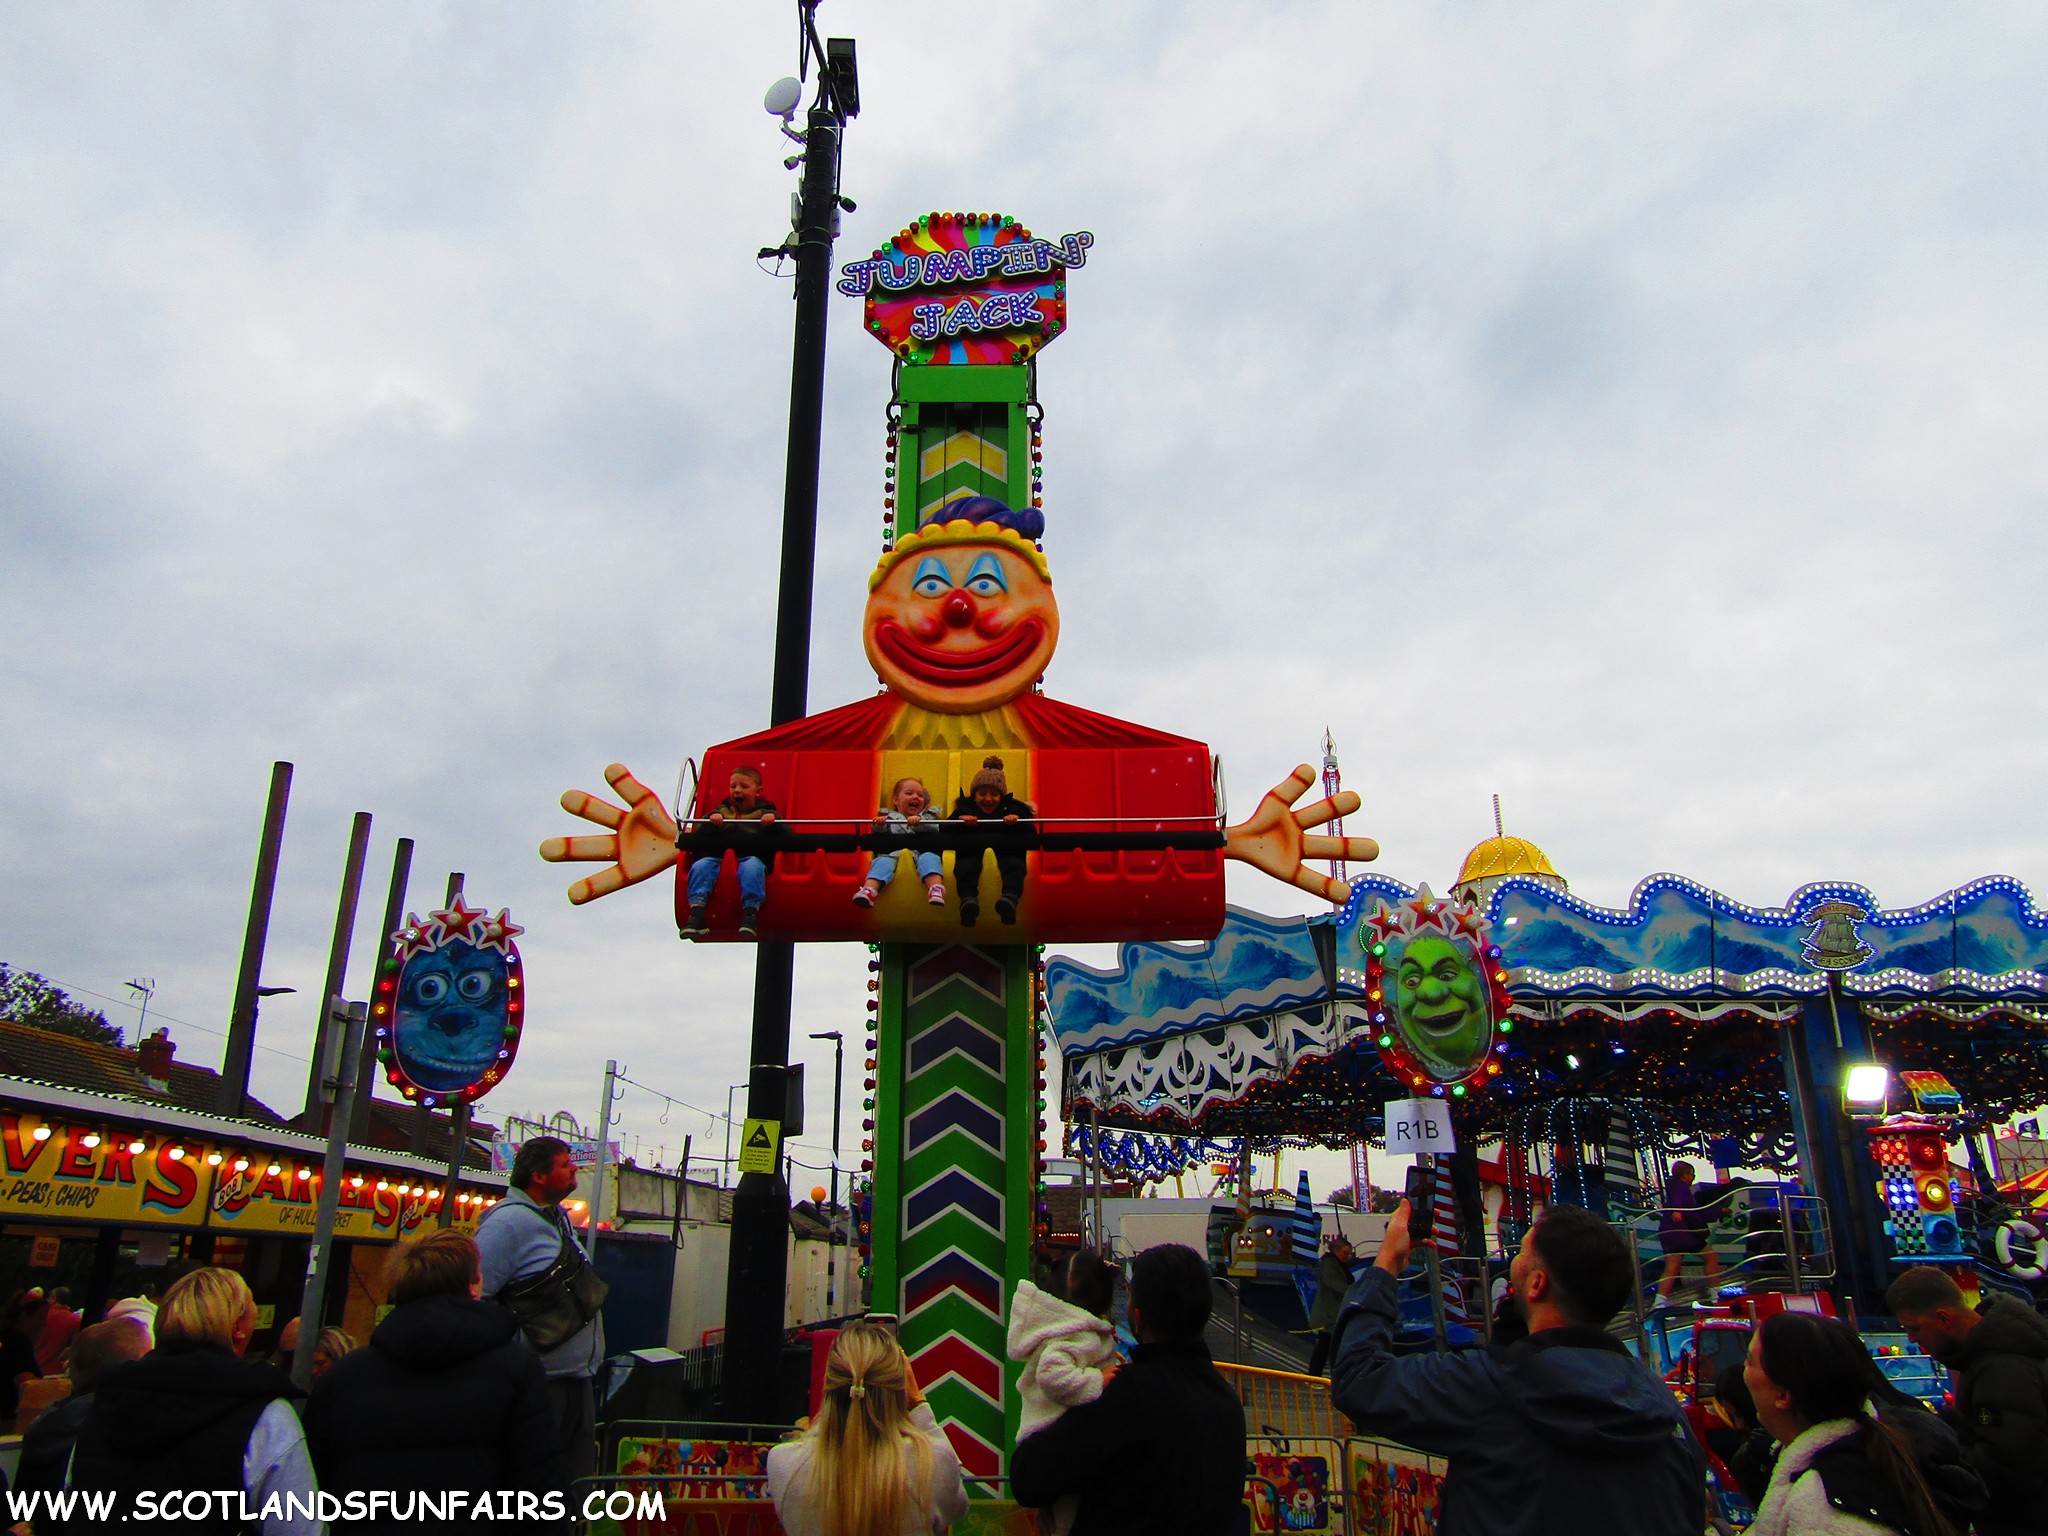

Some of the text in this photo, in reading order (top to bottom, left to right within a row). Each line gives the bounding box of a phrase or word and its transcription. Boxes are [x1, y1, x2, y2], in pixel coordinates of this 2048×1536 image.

[837, 230, 1094, 297] JUMPIN'
[909, 291, 1044, 341] JACK
[1397, 1120, 1439, 1141] R1B
[7, 1179, 50, 1206] PEAS
[56, 1183, 100, 1209] CHIPS
[217, 1178, 238, 1206] BOB
[279, 1206, 294, 1223] OF
